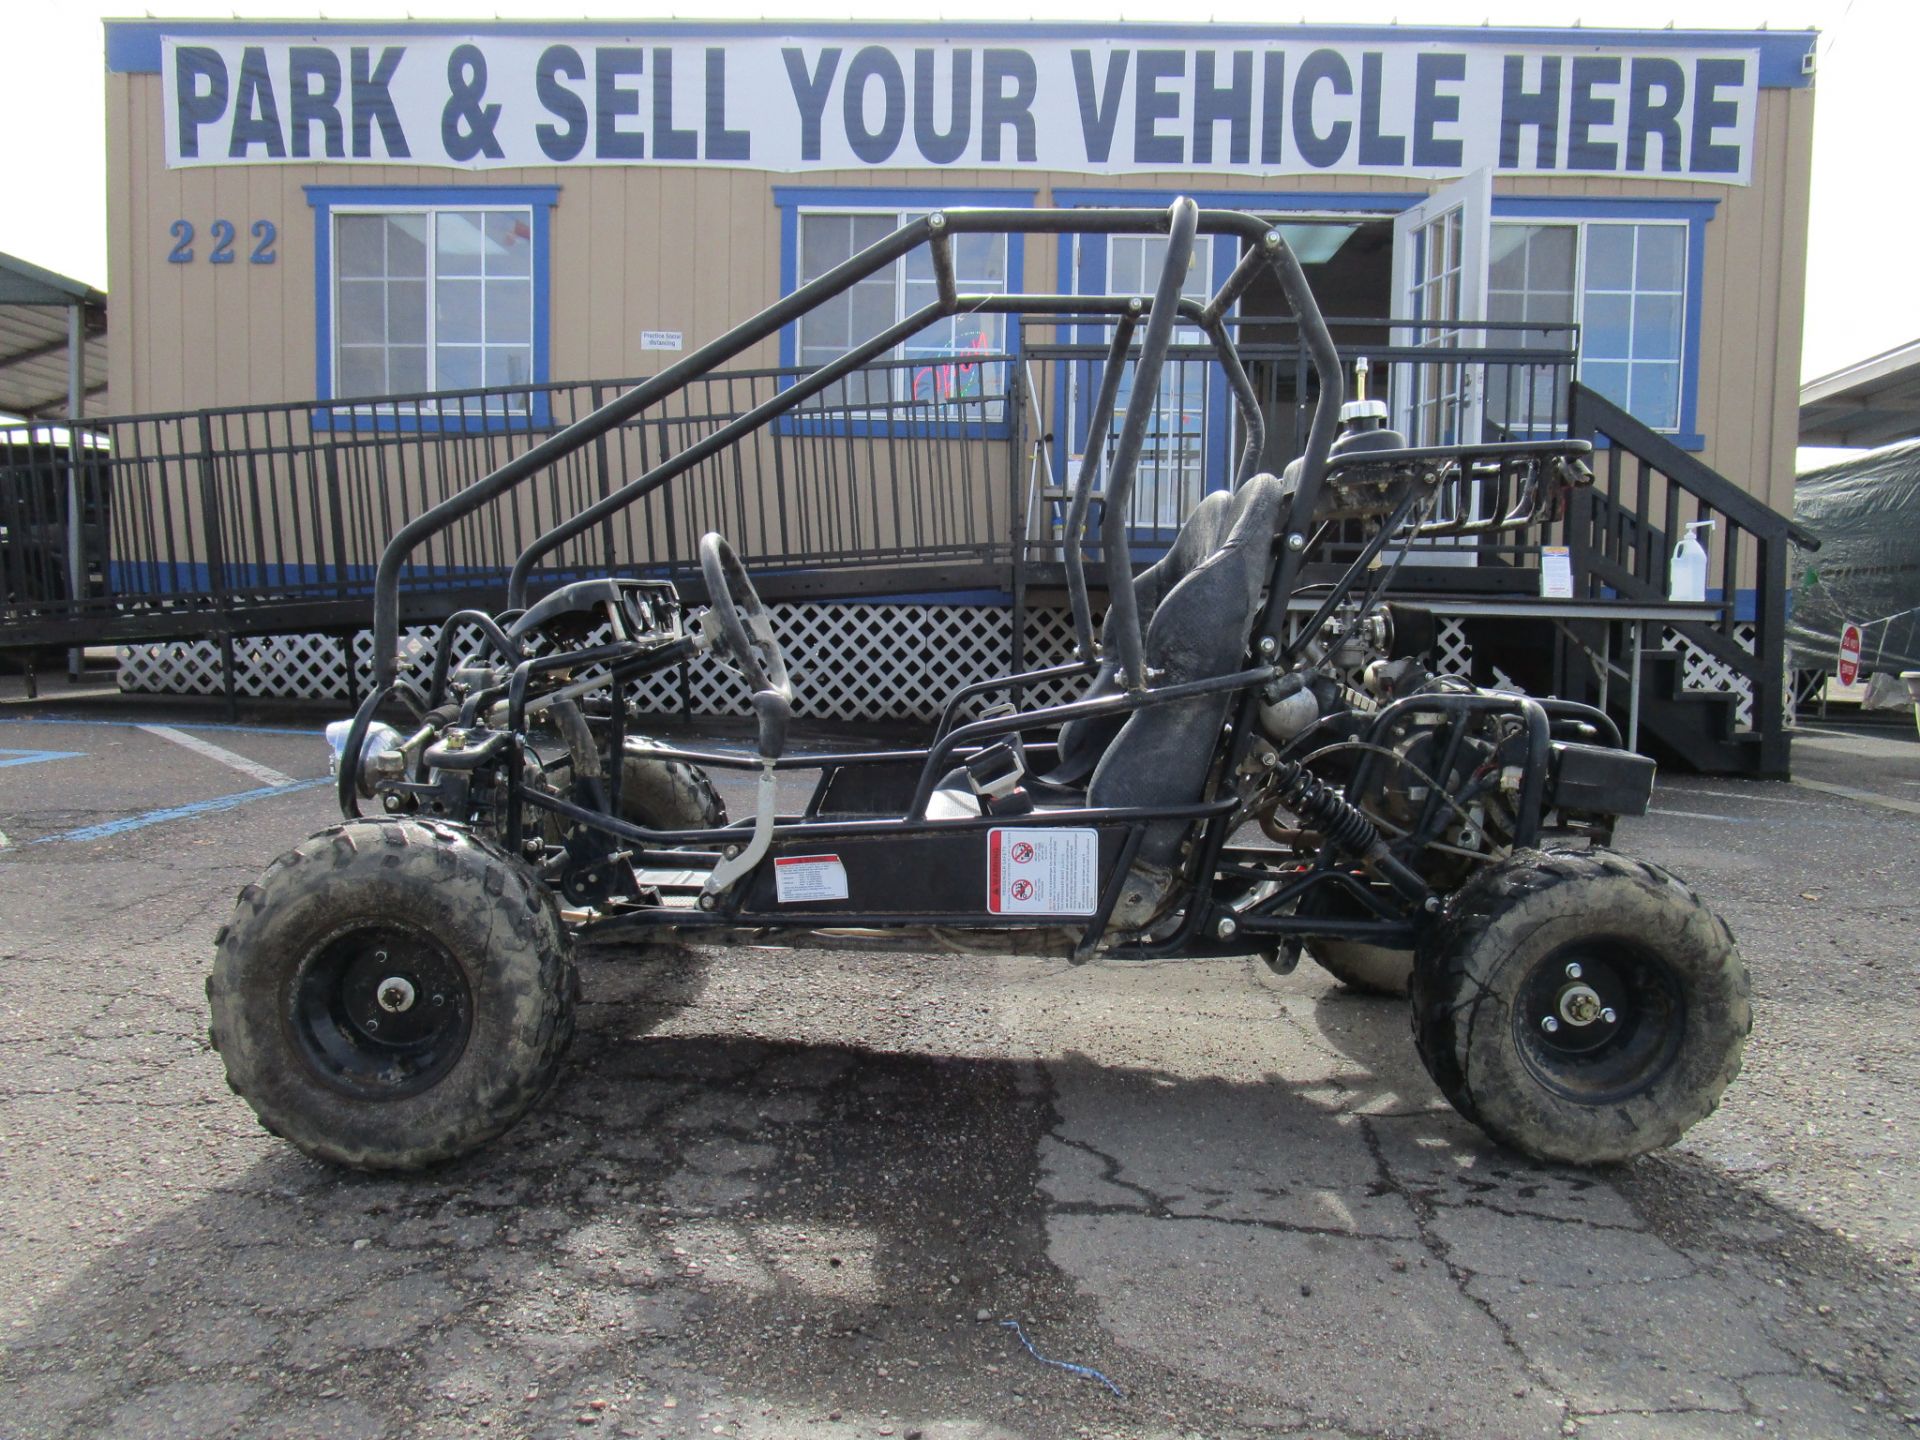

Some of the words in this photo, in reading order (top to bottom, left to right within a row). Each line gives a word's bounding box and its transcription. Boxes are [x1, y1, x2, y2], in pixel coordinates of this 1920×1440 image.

[175, 46, 411, 158] PARK
[441, 44, 506, 162] &
[535, 46, 751, 163] SELL
[783, 49, 1038, 166] YOUR
[1071, 49, 1466, 169] VEHICLE
[1498, 55, 1746, 174] HERE
[167, 219, 276, 265] 222
